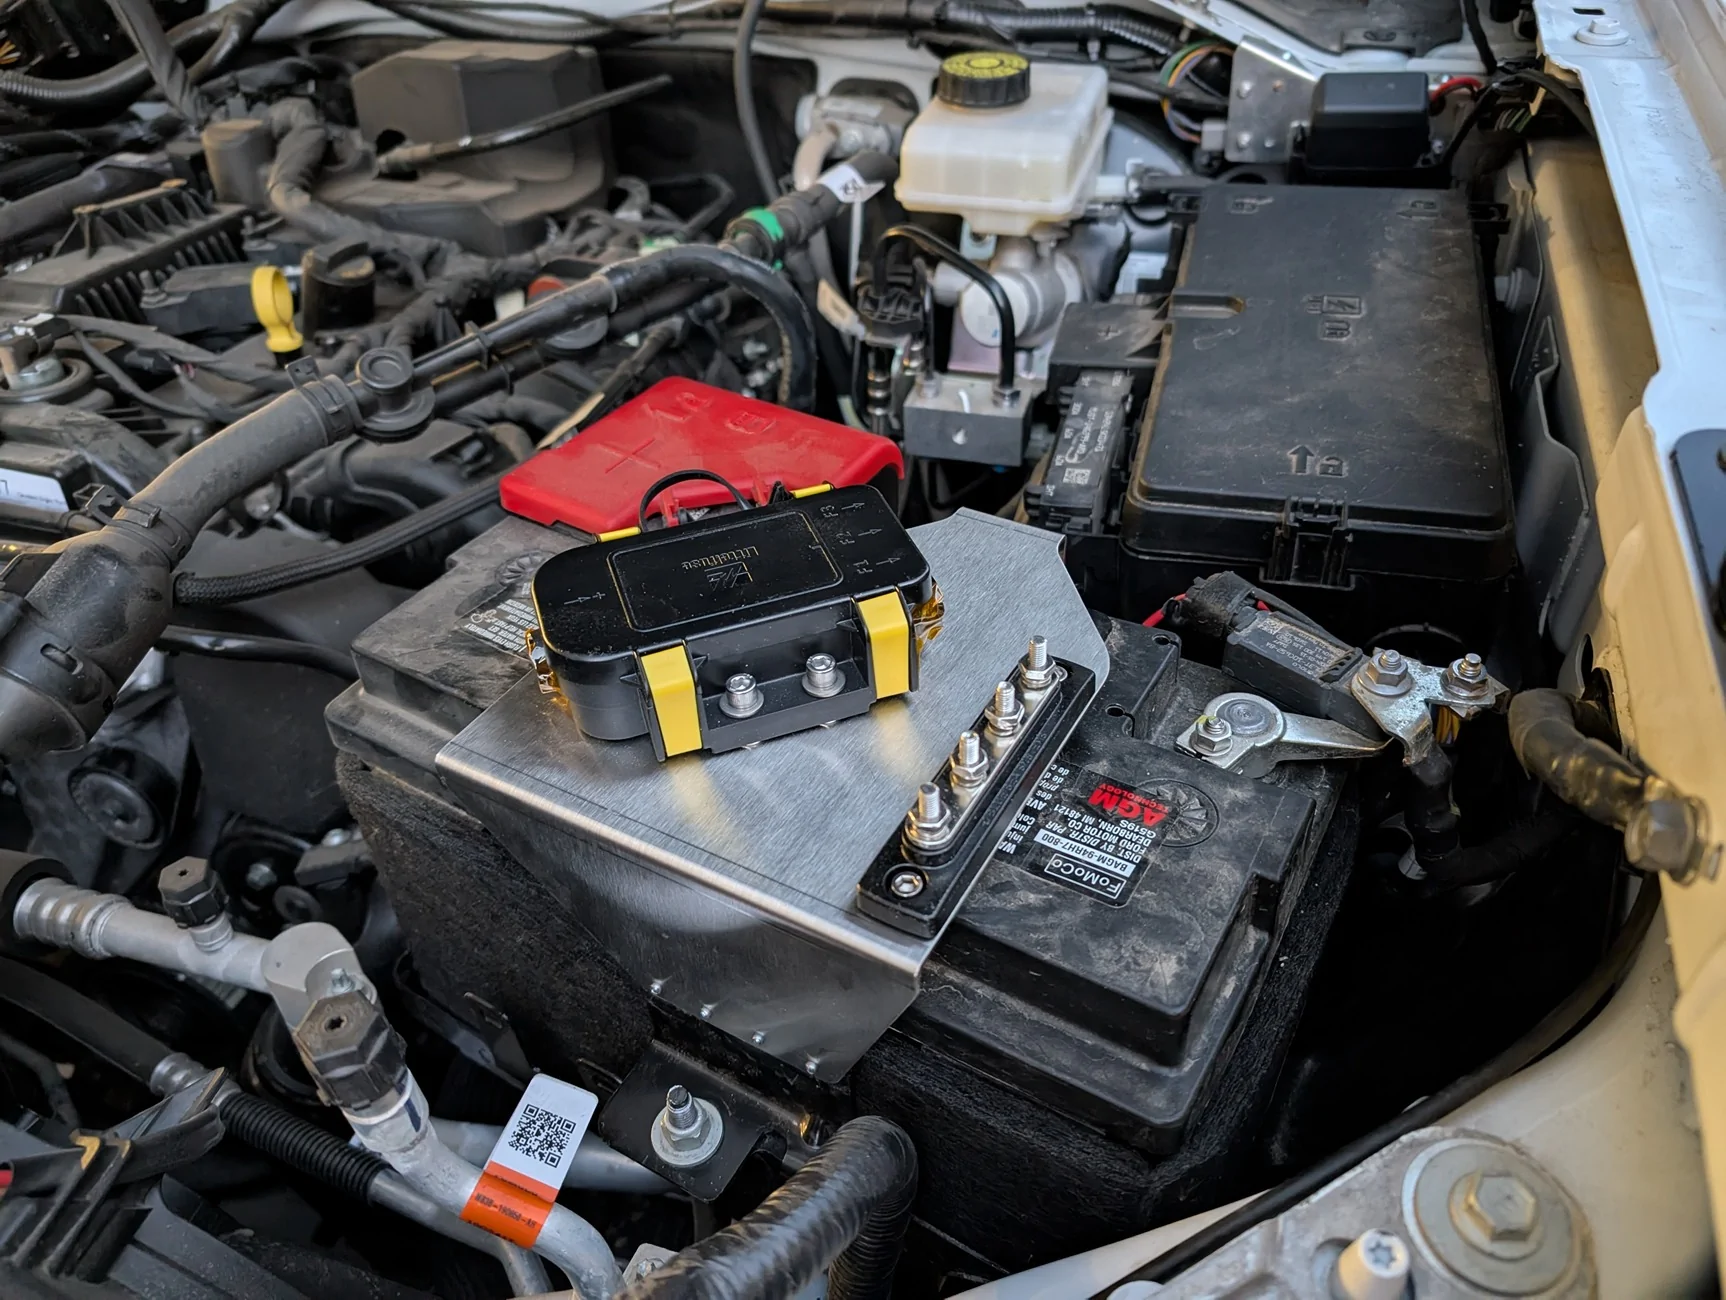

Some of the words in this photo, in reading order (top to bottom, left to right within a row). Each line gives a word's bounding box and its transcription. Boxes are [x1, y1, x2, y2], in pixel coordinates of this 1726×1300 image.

[1057, 766, 1069, 775] de
[1051, 774, 1064, 784] de
[1035, 789, 1052, 800] des
[1098, 782, 1169, 812] TECHNOLOGY
[1053, 803, 1081, 818] 48121
[1086, 788, 1166, 826] AGM
[1065, 817, 1083, 829] CO.
[1081, 813, 1095, 823] MI
[1045, 820, 1066, 833] PAR
[1082, 823, 1118, 843] MOTOR
[1095, 817, 1151, 846] DEARBORN,
[1118, 818, 1156, 839] G519S
[1066, 828, 1100, 846] DISTR.
[1040, 832, 1127, 871] BAGM-94RH7-800
[1099, 841, 1114, 852] BY
[1118, 838, 1146, 854] FORD
[1114, 847, 1141, 863] DIST.
[1049, 857, 1121, 893] FoMoCo
